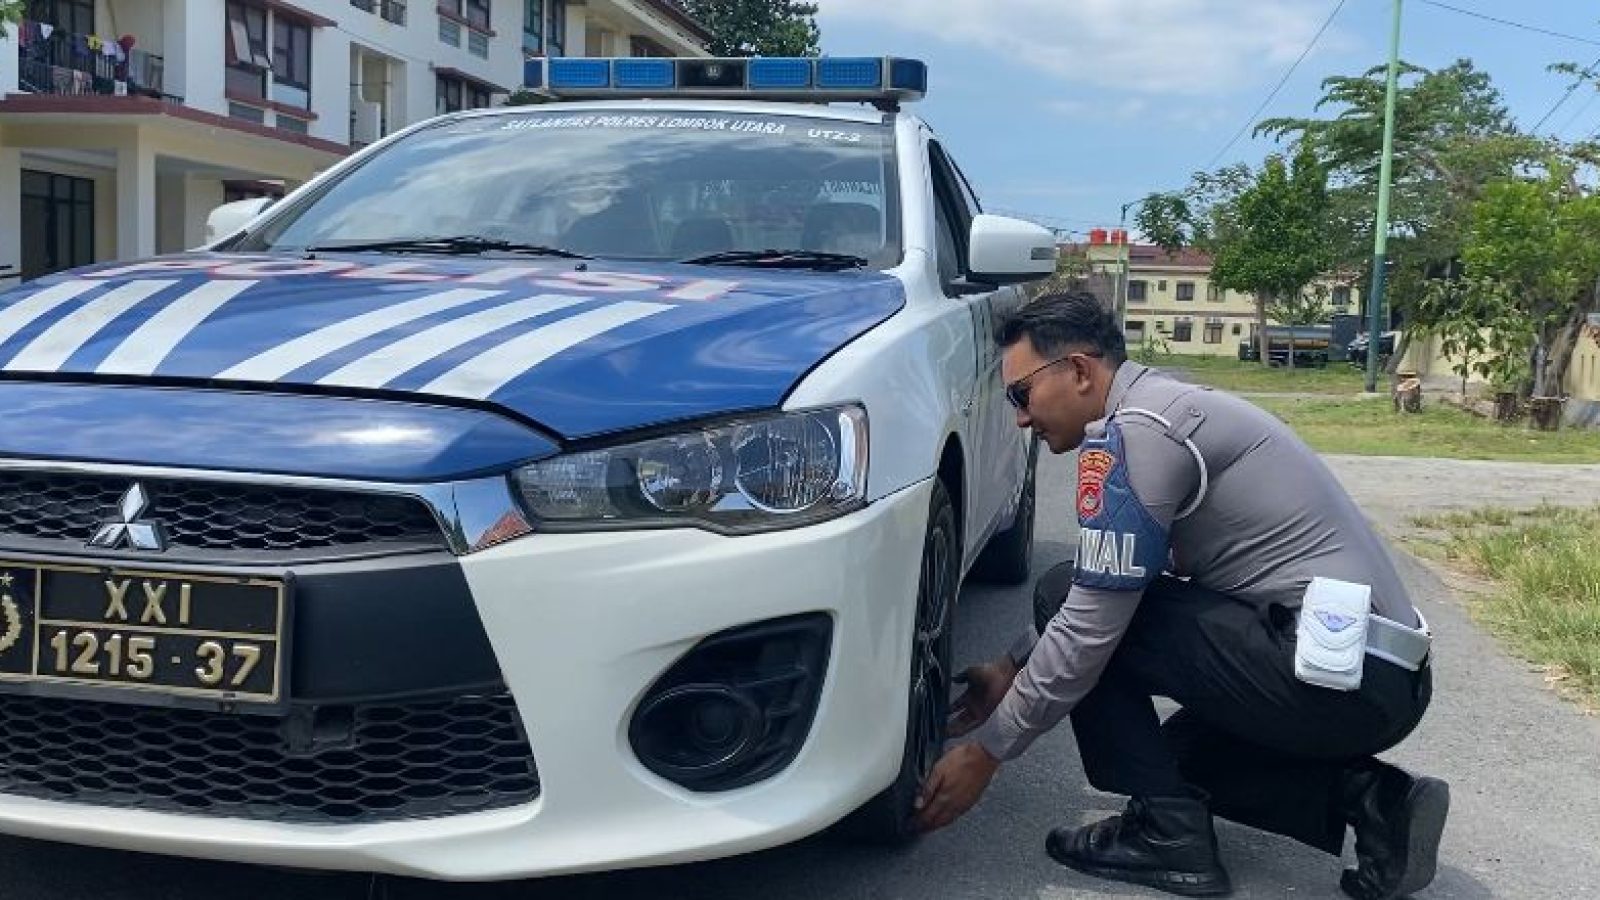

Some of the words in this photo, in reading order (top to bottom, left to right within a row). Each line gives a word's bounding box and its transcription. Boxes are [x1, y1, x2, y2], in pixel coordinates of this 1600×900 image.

[594, 115, 656, 128] POLRES
[657, 118, 728, 130] LOMBOK
[730, 120, 787, 134] UTARA
[80, 257, 741, 301] POLISI
[103, 578, 193, 625] XXI
[50, 629, 156, 679] 1215
[194, 641, 262, 687] 37
